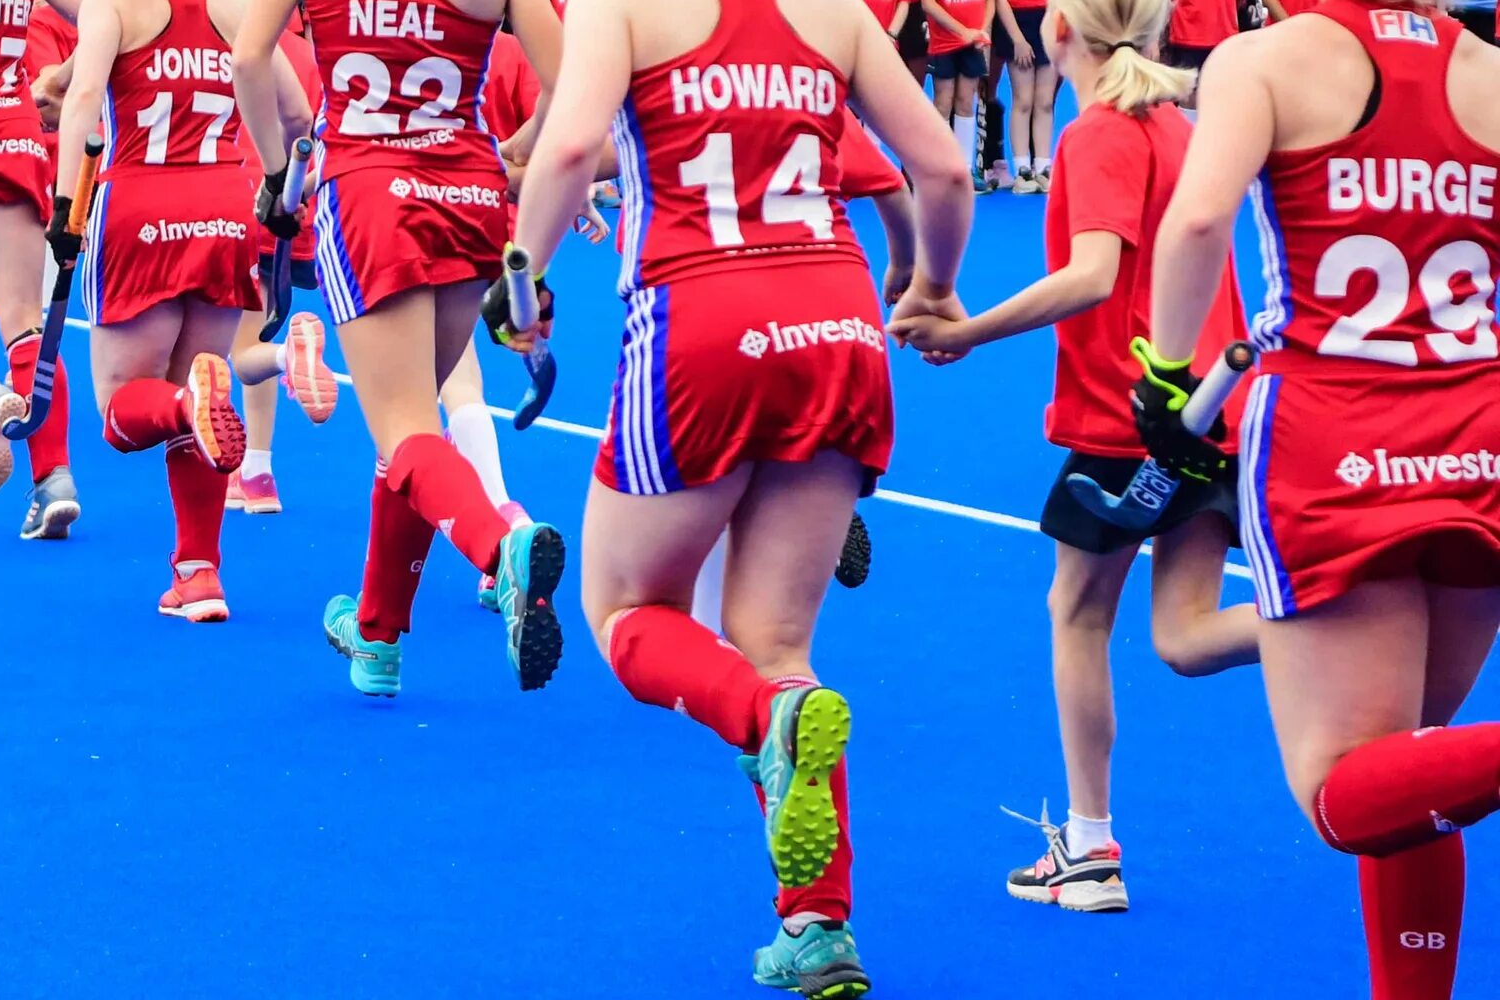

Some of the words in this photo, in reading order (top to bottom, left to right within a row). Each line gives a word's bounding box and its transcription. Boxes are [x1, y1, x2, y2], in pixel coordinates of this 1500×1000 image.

[147, 48, 233, 81] JONES
[671, 63, 837, 116] HOWARD
[332, 53, 466, 135] 22
[137, 91, 235, 165] 17
[410, 178, 500, 208] Investec
[680, 132, 835, 248] 14
[1328, 158, 1498, 219] BURGE
[160, 218, 246, 242] Investec
[1314, 234, 1499, 366] 29
[767, 316, 885, 353] Investec
[1129, 458, 1176, 509] Gray
[1400, 931, 1446, 950] GB
